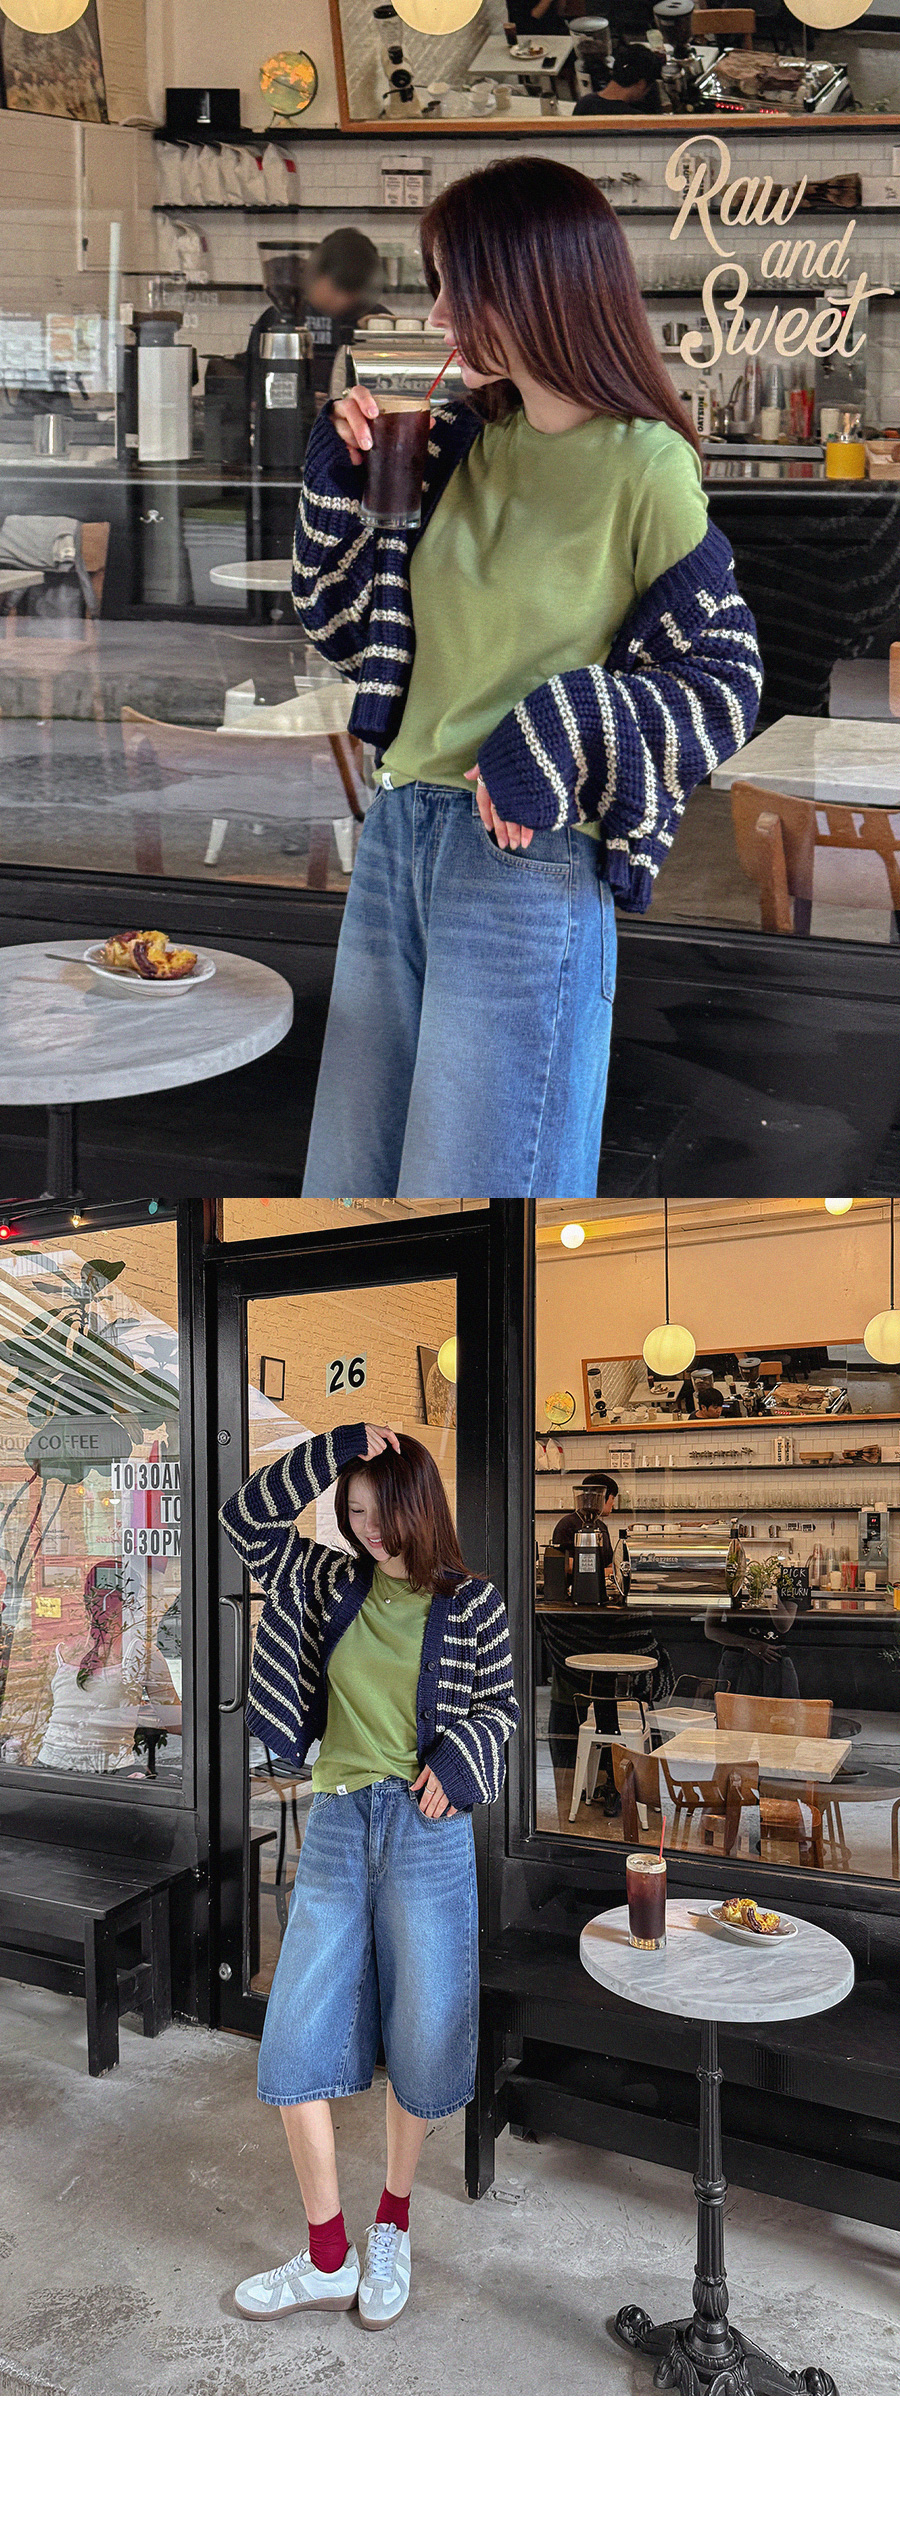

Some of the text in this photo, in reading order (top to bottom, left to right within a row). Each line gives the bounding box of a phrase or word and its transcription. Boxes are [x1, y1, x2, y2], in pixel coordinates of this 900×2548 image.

[665, 134, 808, 257] Raw
[761, 219, 856, 278] and
[680, 263, 895, 369] Sweet
[330, 1357, 365, 1393] 26
[38, 1434, 99, 1450] COFFEE
[782, 1568, 806, 1578] PICK
[781, 1587, 809, 1597] RETURN
